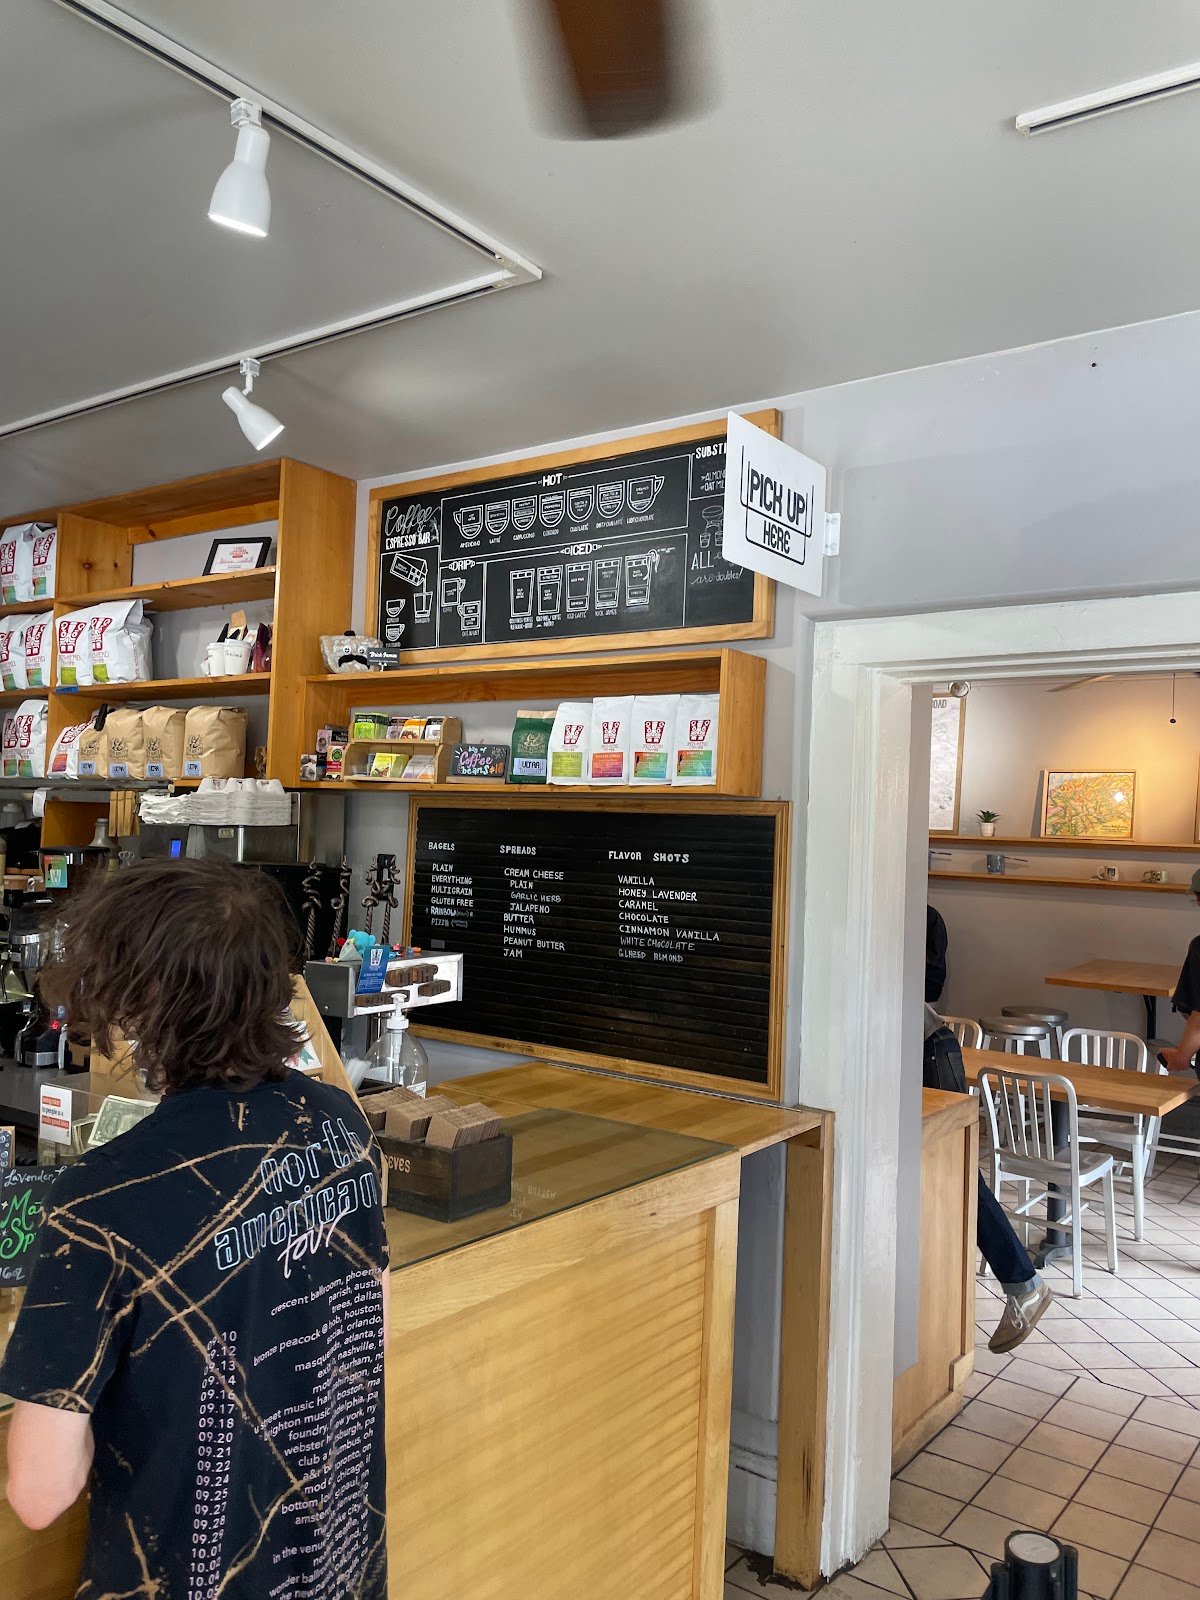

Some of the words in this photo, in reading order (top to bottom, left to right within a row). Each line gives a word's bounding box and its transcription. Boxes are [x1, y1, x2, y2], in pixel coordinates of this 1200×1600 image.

[542, 473, 563, 487] HOT
[750, 468, 784, 517] PICK
[787, 488, 806, 526] UP
[385, 503, 440, 536] Coffee
[386, 533, 417, 550] ESPRESSO
[418, 532, 430, 544] BAR
[762, 520, 791, 554] HERE
[570, 543, 592, 556] ICED
[452, 560, 471, 572] DRIP
[691, 551, 714, 570] ALL
[460, 751, 493, 766] Coffee
[461, 764, 490, 776] beans
[428, 842, 455, 851] BAGELS
[500, 844, 536, 856] SPREADS
[608, 851, 642, 860] FLAVOR
[653, 852, 690, 863] SHOTS
[432, 863, 454, 872] PLAIN
[504, 868, 530, 878] CREAM
[532, 870, 564, 880] CHEESE
[431, 874, 472, 884] EVERYTHING
[510, 880, 534, 890] PLAIN
[618, 874, 654, 886] VANILLA
[430, 886, 472, 896] MULTIGRAIN
[510, 892, 538, 902] GARLIC
[540, 895, 562, 903] HERB
[618, 888, 647, 898] HONEY
[652, 890, 698, 902] LAVENDER
[430, 896, 455, 906] GLUTEN
[456, 898, 474, 908] FREE
[510, 902, 550, 914] JALAPENO
[618, 900, 658, 911] CARAMEL
[504, 913, 534, 924] BUTTER
[618, 912, 669, 924] CHOCOLATE
[619, 924, 670, 937] CINNAMON
[676, 929, 720, 941] VANILLA
[504, 936, 533, 946] PEANUT
[536, 940, 566, 951] BUTTER
[620, 936, 646, 947] WHITE
[647, 938, 696, 950] CHOCOLATE
[504, 949, 523, 958] JAM
[654, 952, 684, 962] ALMOND
[260, 1118, 364, 1195] north
[214, 1172, 378, 1270] american
[270, 1296, 309, 1316] crescent
[279, 1329, 320, 1354] peacock
[344, 1332, 376, 1345] atlanta,
[200, 1389, 236, 1402] 09.16
[200, 1402, 234, 1414] 09.17
[284, 1400, 314, 1416] music
[198, 1417, 234, 1428] 09.18
[288, 1424, 330, 1442] foundry,
[368, 1390, 379, 1402] pa
[198, 1432, 234, 1444] 09.20
[364, 1428, 374, 1440] oh
[198, 1446, 231, 1458] 09.21
[284, 1439, 324, 1456] webster
[197, 1460, 231, 1472] 09.22
[298, 1454, 320, 1466] club
[196, 1474, 230, 1487] 09.24
[304, 1478, 326, 1494] mod
[196, 1488, 228, 1502] 09.25
[194, 1502, 227, 1516] 09.27
[282, 1500, 318, 1514] bottom
[193, 1515, 226, 1530] 09.28
[192, 1529, 224, 1544] 09.29
[192, 1543, 222, 1558] 10.01
[272, 1554, 281, 1564] in
[282, 1546, 298, 1560] the
[190, 1556, 222, 1572] 10.02
[189, 1571, 220, 1587] 10.04
